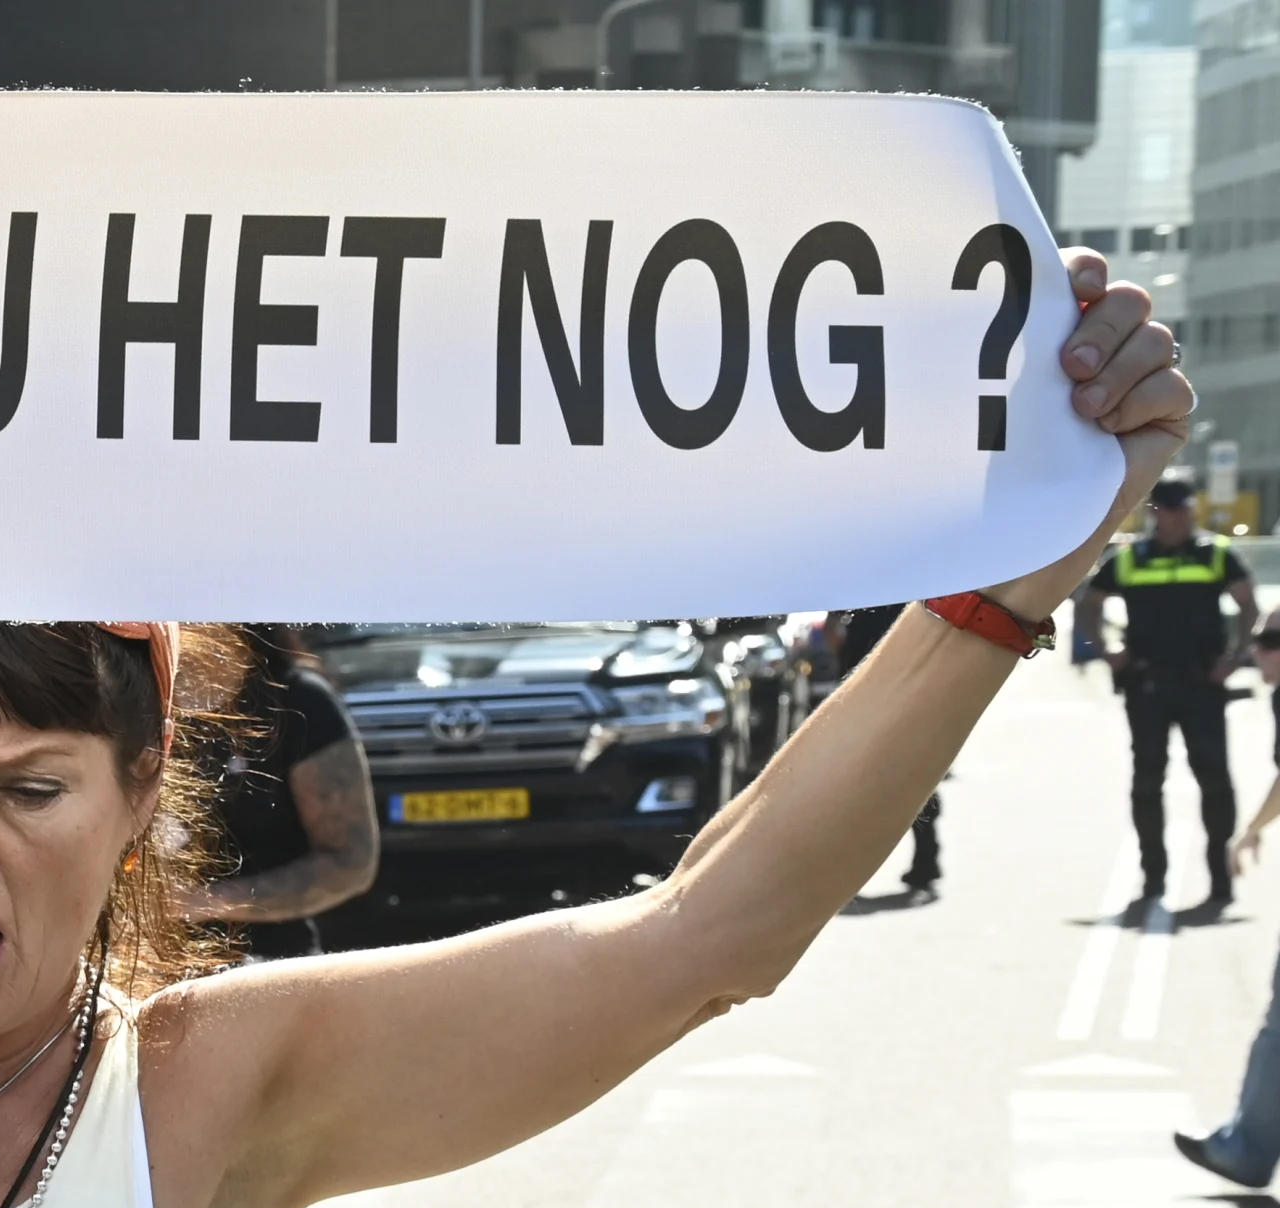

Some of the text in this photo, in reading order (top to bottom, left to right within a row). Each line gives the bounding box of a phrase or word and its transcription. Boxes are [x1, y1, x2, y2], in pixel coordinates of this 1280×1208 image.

[96, 214, 447, 444] HET
[495, 218, 886, 453] NOG
[950, 223, 1033, 452] ?
